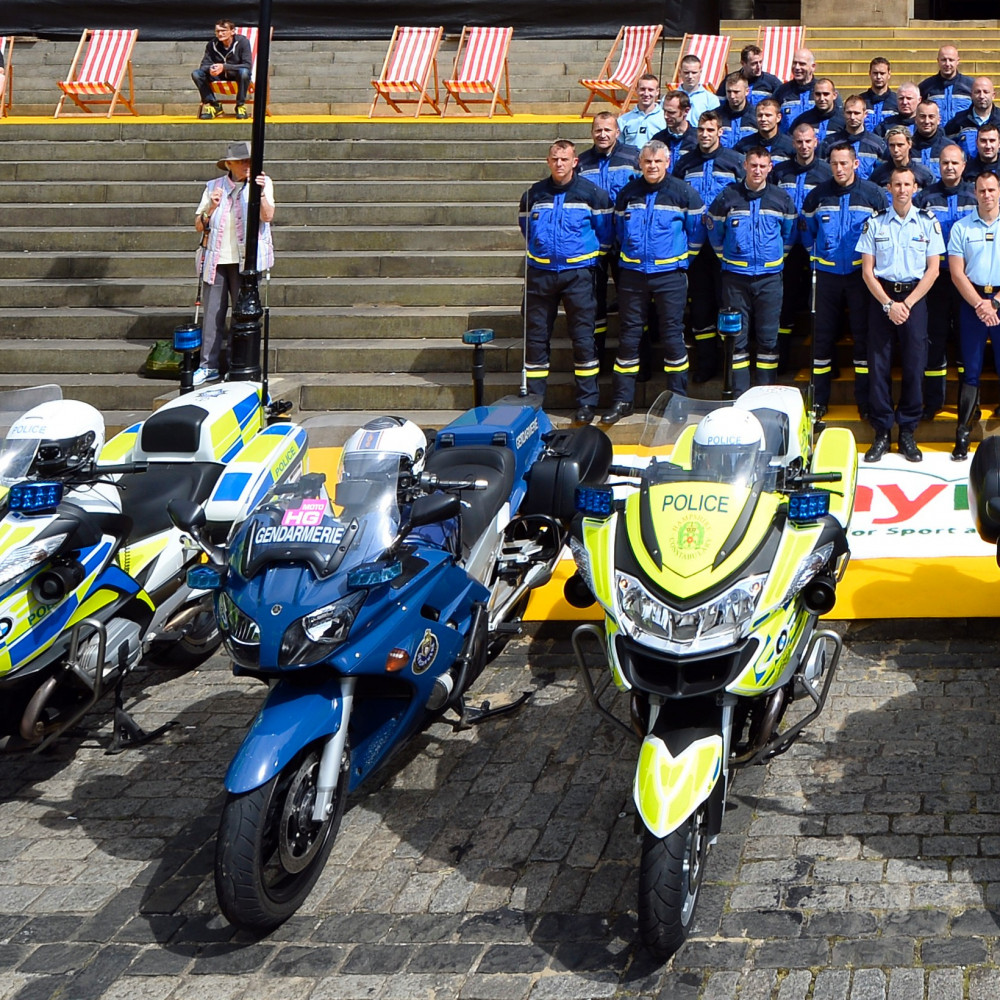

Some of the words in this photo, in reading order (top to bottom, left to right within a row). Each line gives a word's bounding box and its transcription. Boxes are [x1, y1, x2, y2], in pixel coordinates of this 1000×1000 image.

[11, 425, 47, 435] POLICE
[707, 436, 742, 445] POLICE
[275, 446, 297, 477] POLICE
[662, 494, 729, 513] POLICE
[285, 511, 320, 525] HG
[255, 526, 345, 544] GENDARMERIE
[886, 527, 956, 536] Sport
